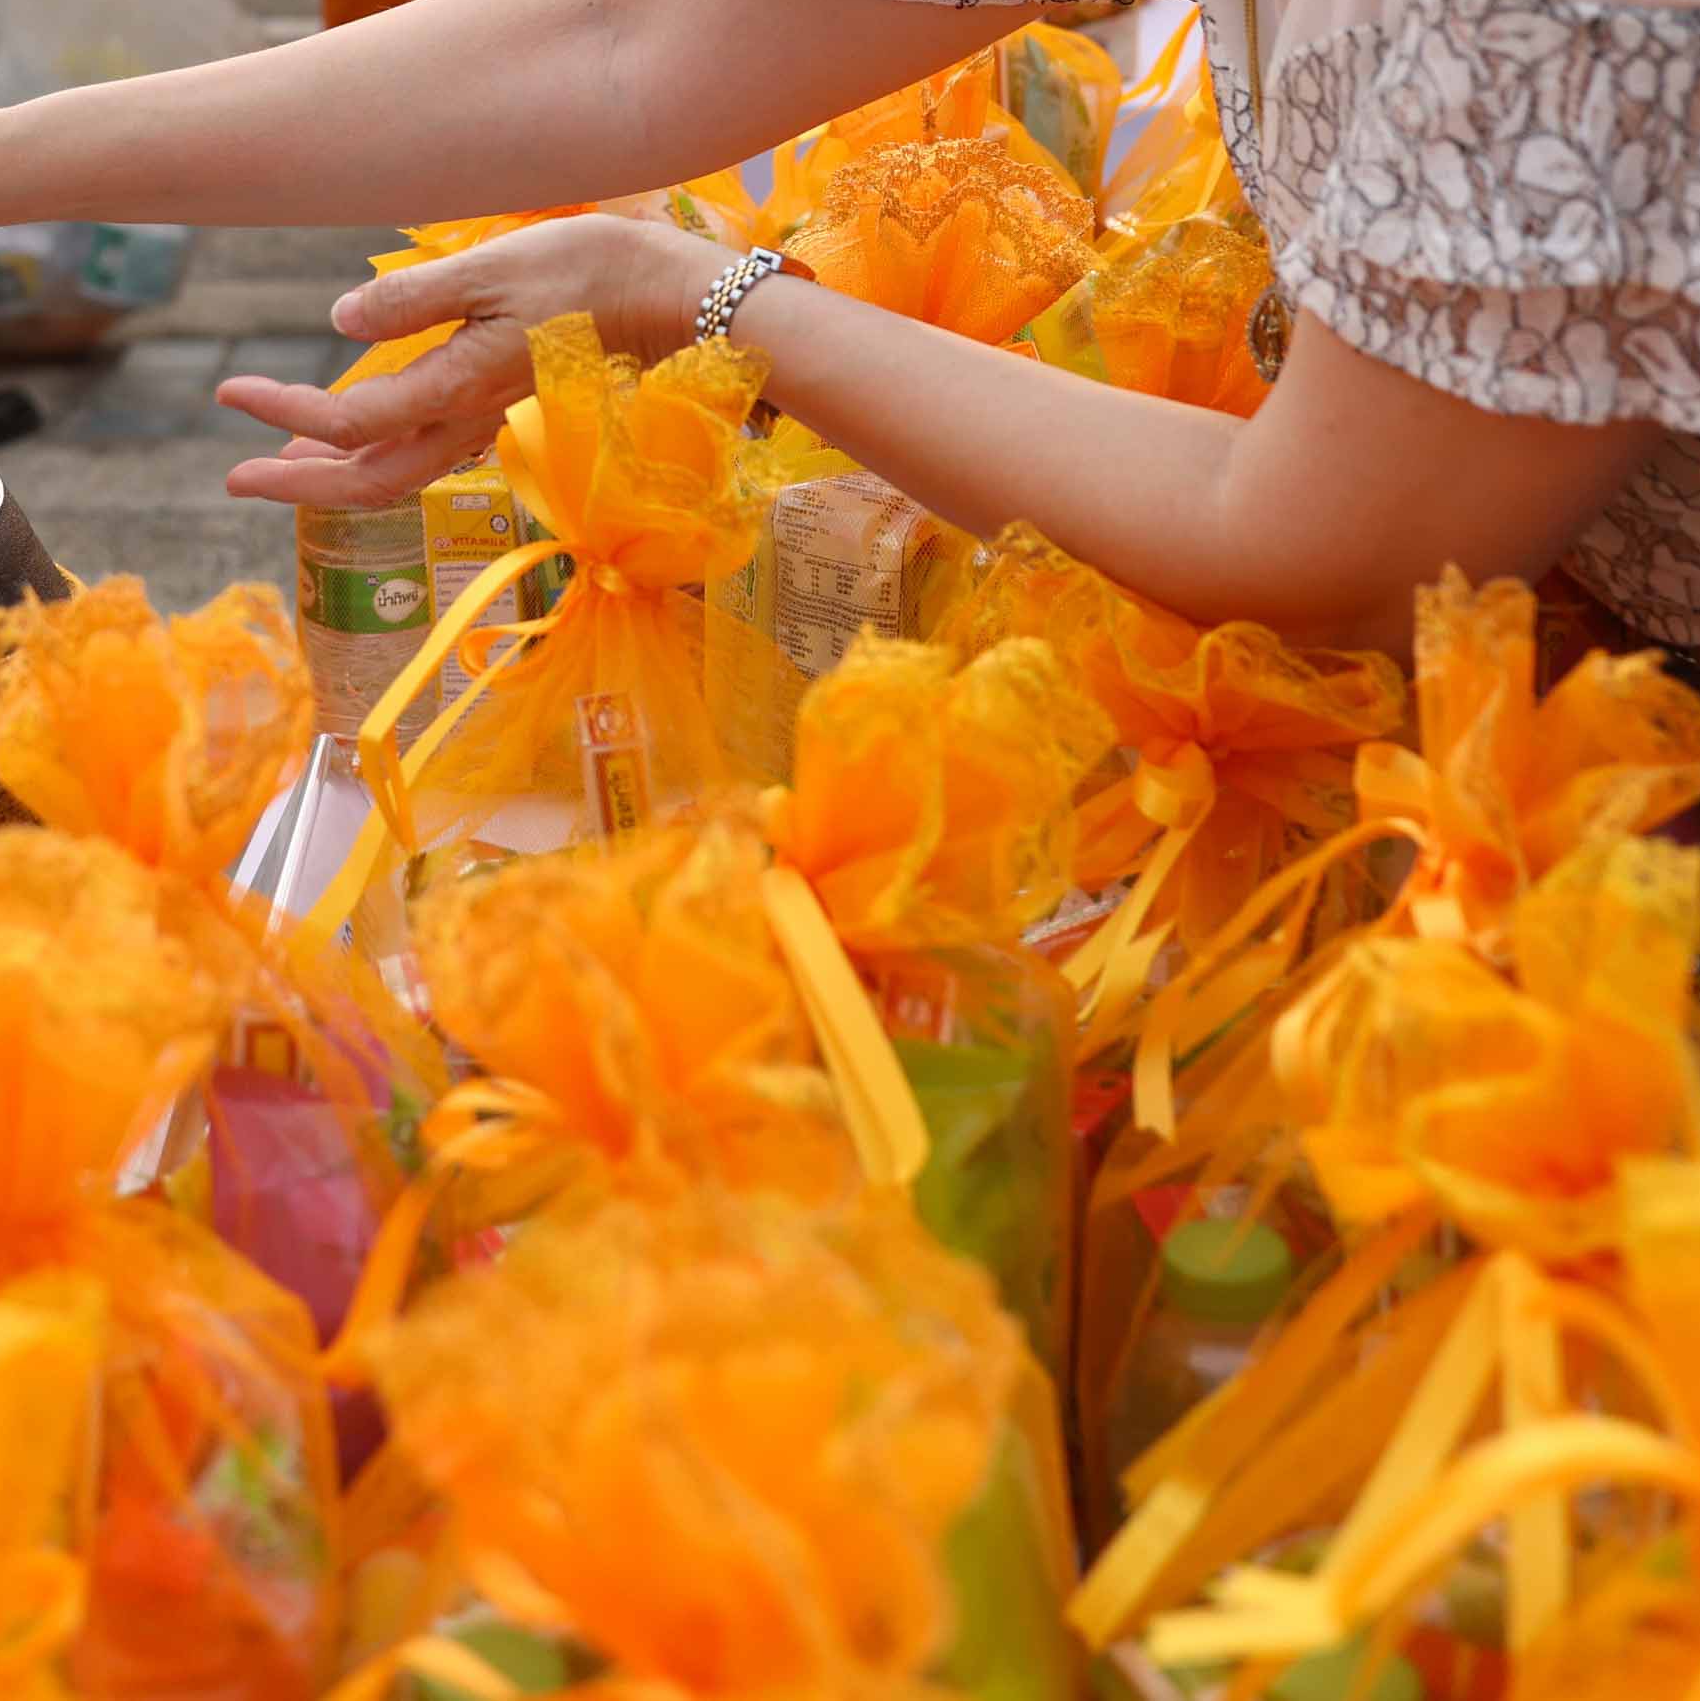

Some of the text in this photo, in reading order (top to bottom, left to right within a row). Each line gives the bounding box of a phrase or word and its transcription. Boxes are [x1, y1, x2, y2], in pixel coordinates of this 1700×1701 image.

[452, 538, 508, 547] VITAMILK
[378, 586, 420, 607] น้ำทิพย์
